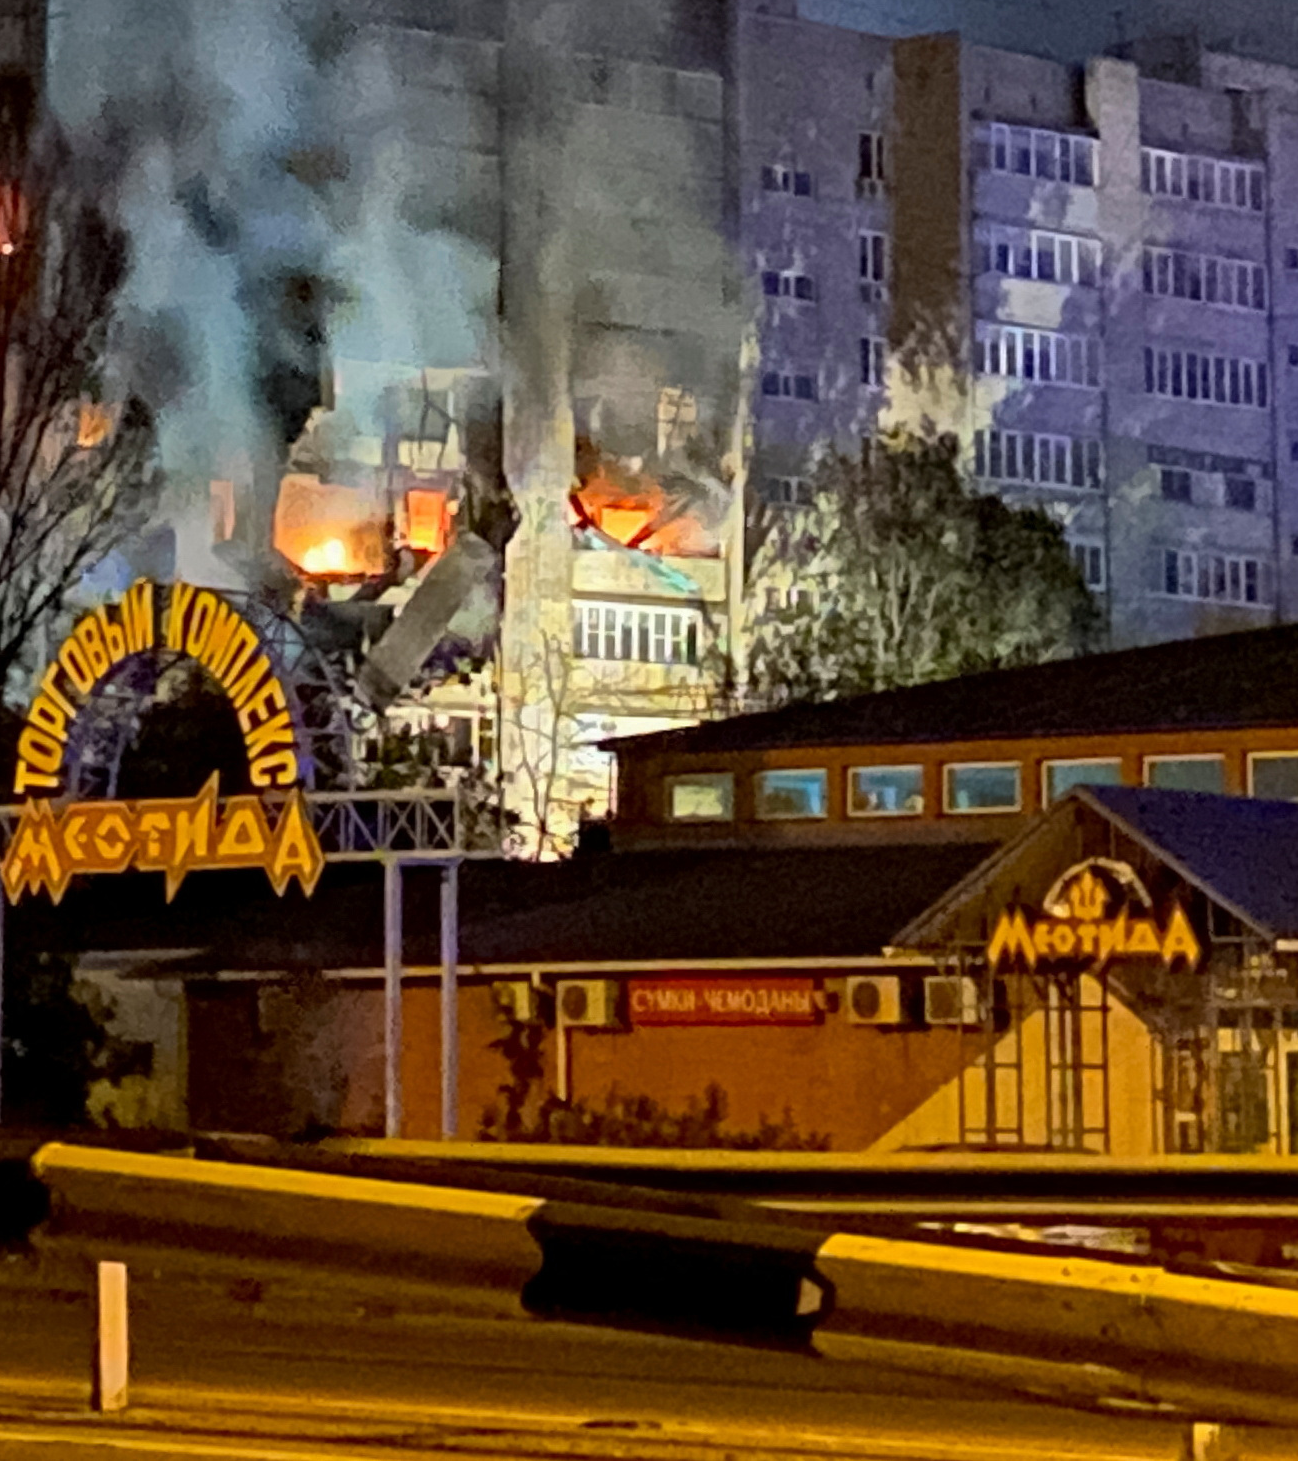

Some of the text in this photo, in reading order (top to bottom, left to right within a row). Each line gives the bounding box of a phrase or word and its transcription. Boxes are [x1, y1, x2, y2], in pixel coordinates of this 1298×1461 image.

[13, 577, 298, 794] ТОРГОВЫЙ КОМПЛЕКС
[3, 775, 323, 901] МЕОТИДА
